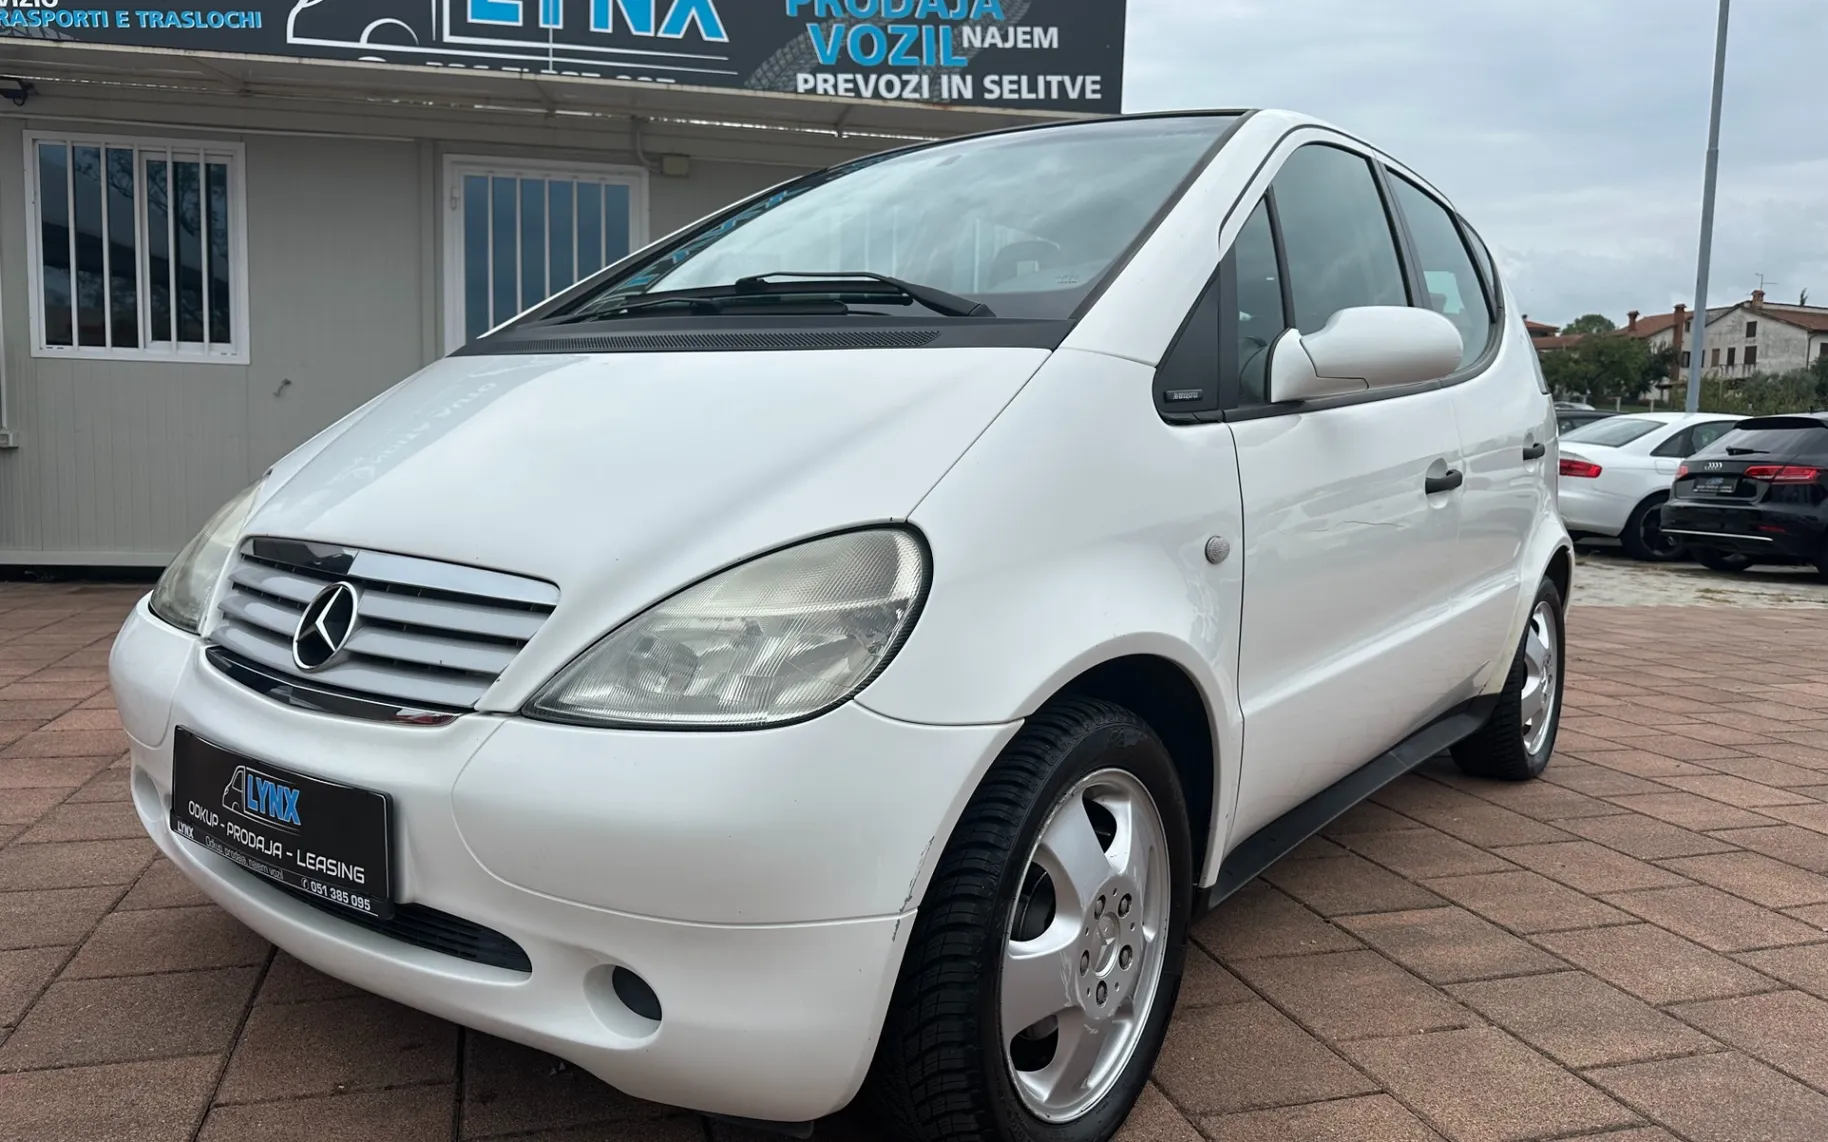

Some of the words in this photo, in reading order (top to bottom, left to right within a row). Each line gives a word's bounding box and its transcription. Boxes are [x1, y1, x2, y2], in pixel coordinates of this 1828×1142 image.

[115, 10, 131, 28] E
[134, 10, 263, 29] TRASLOCHI
[805, 23, 969, 67] VOZIL
[961, 25, 1060, 49] NAJEM
[795, 72, 930, 100] PREVOZI
[940, 74, 974, 100] IN
[982, 74, 1103, 100] SELITVE
[247, 773, 302, 826] LYNX
[177, 820, 195, 839] LYNX
[188, 800, 219, 827] ODKUP
[226, 821, 283, 859] PRODAJA
[296, 849, 365, 884] LEASING
[310, 881, 328, 897] 051
[330, 887, 349, 904] 385
[350, 894, 371, 911] 095
